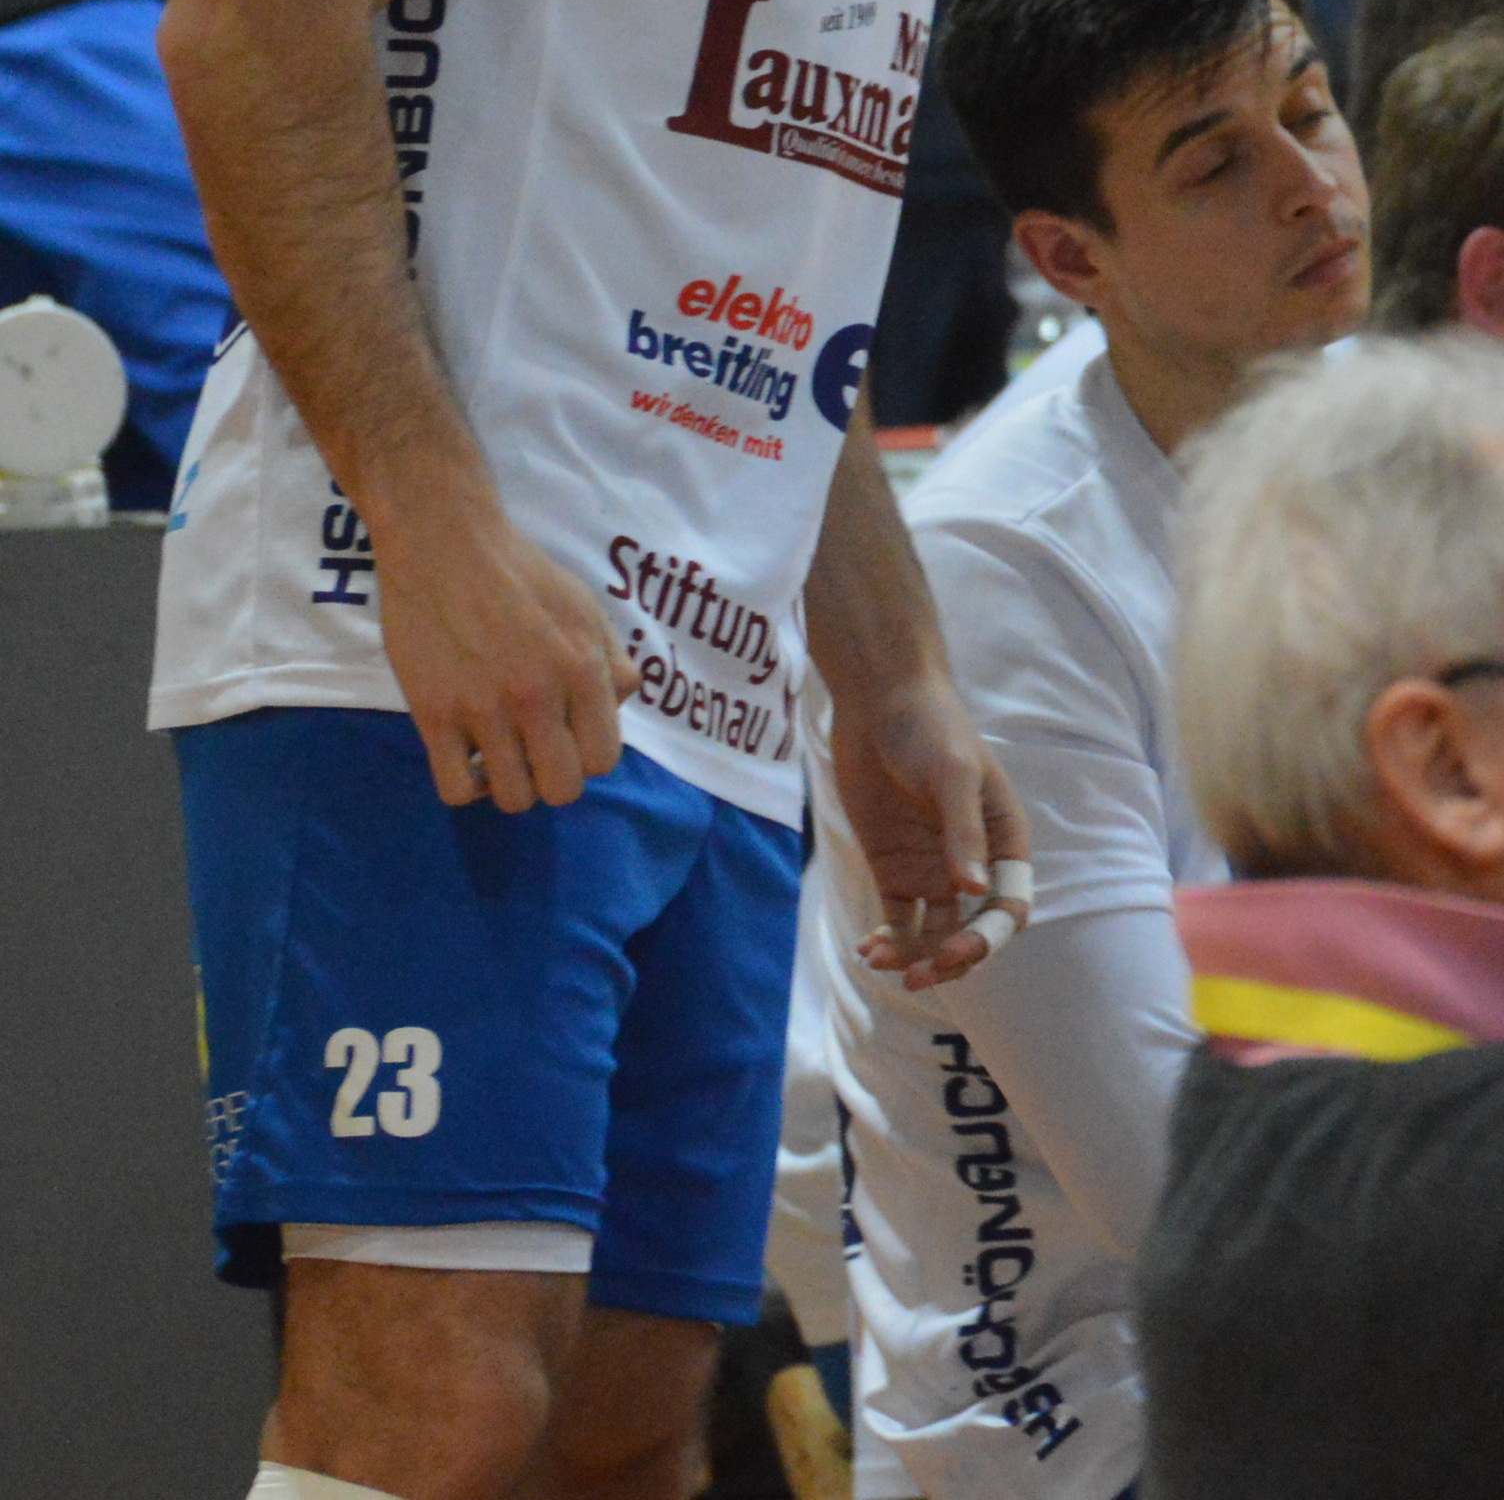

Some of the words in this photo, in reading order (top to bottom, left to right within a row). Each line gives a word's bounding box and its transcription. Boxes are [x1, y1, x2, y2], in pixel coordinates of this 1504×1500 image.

[677, 273, 814, 352] elektro
[627, 308, 798, 422] breitling
[631, 390, 673, 418] wir
[668, 402, 741, 448] denken
[743, 434, 785, 462] mit
[323, 1025, 444, 1138] 23
